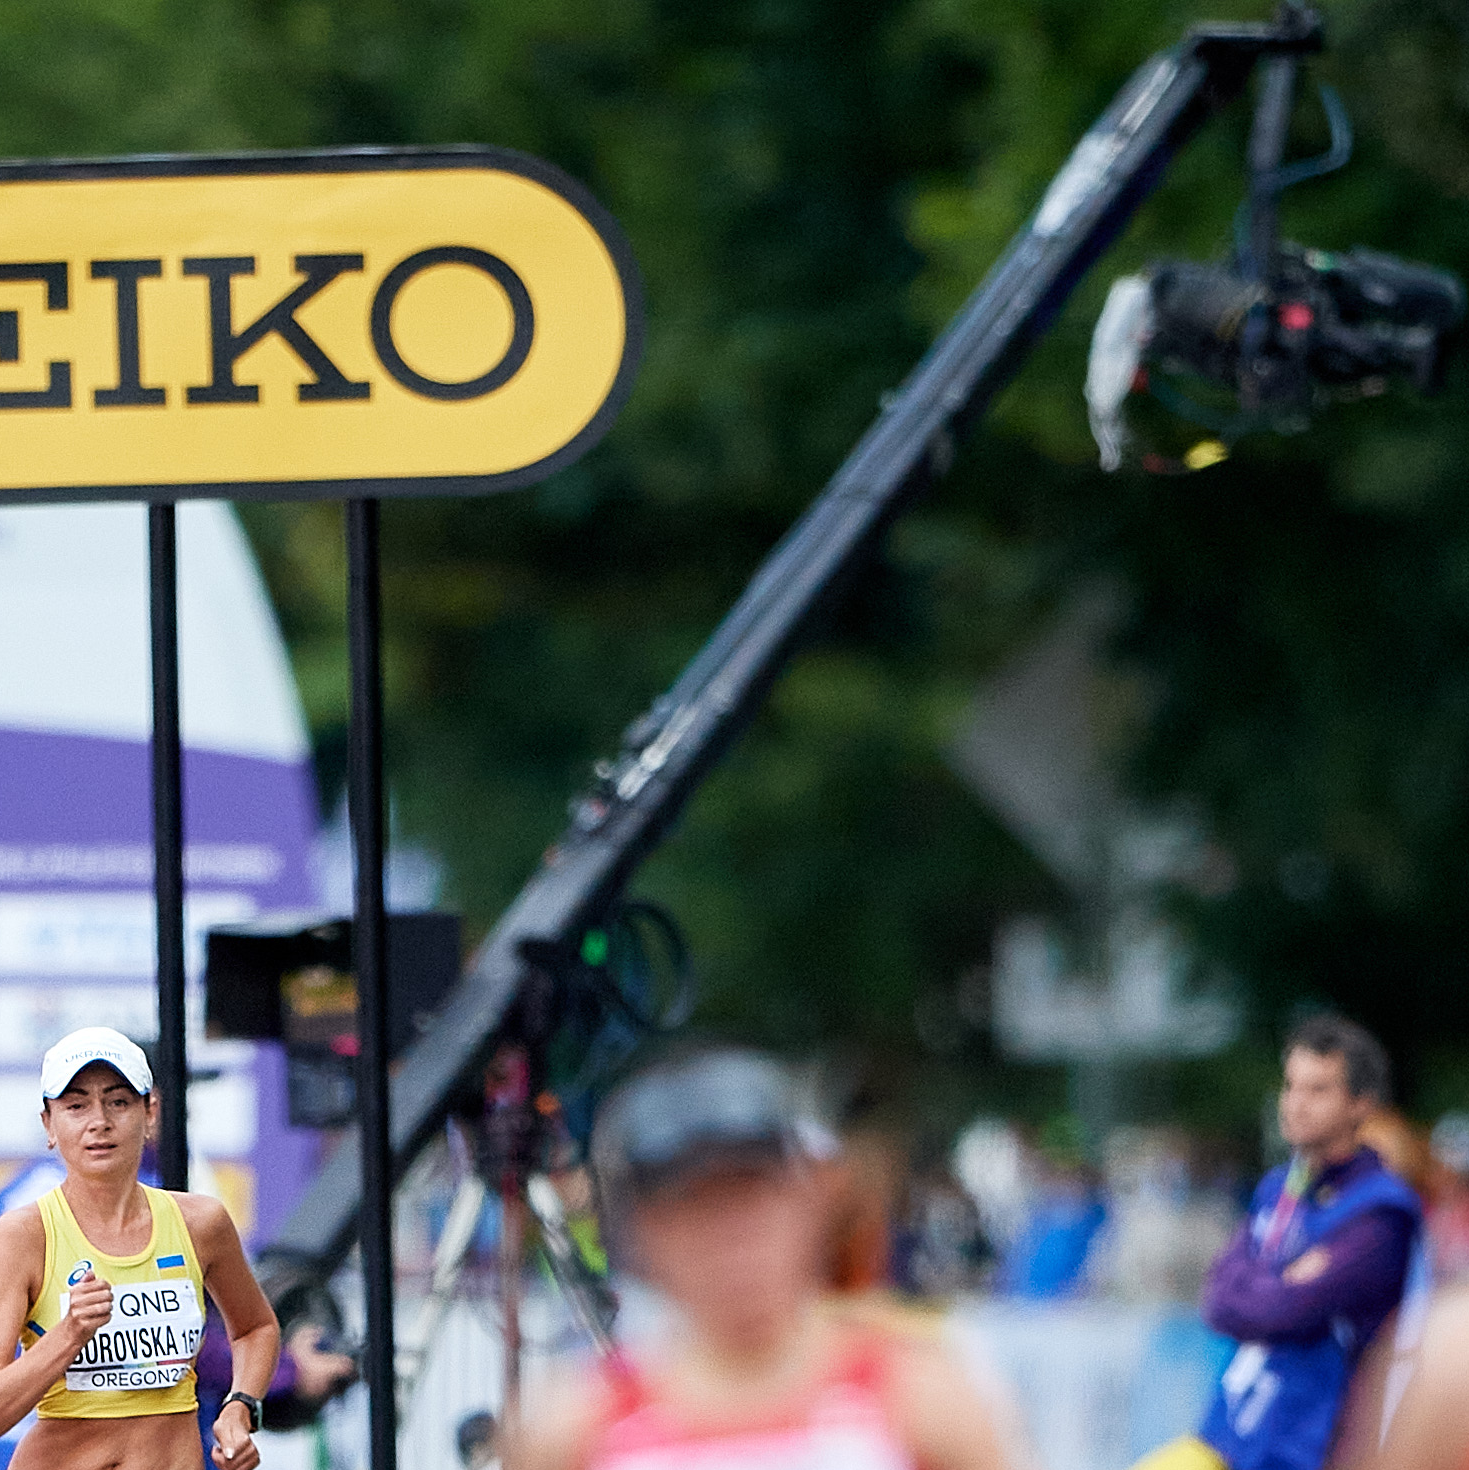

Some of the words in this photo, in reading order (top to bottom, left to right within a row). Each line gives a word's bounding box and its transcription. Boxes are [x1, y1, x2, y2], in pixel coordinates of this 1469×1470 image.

[65, 1050, 123, 1063] UKRAINE
[119, 1290, 180, 1317] QNB
[91, 1368, 186, 1387] OREGON2
